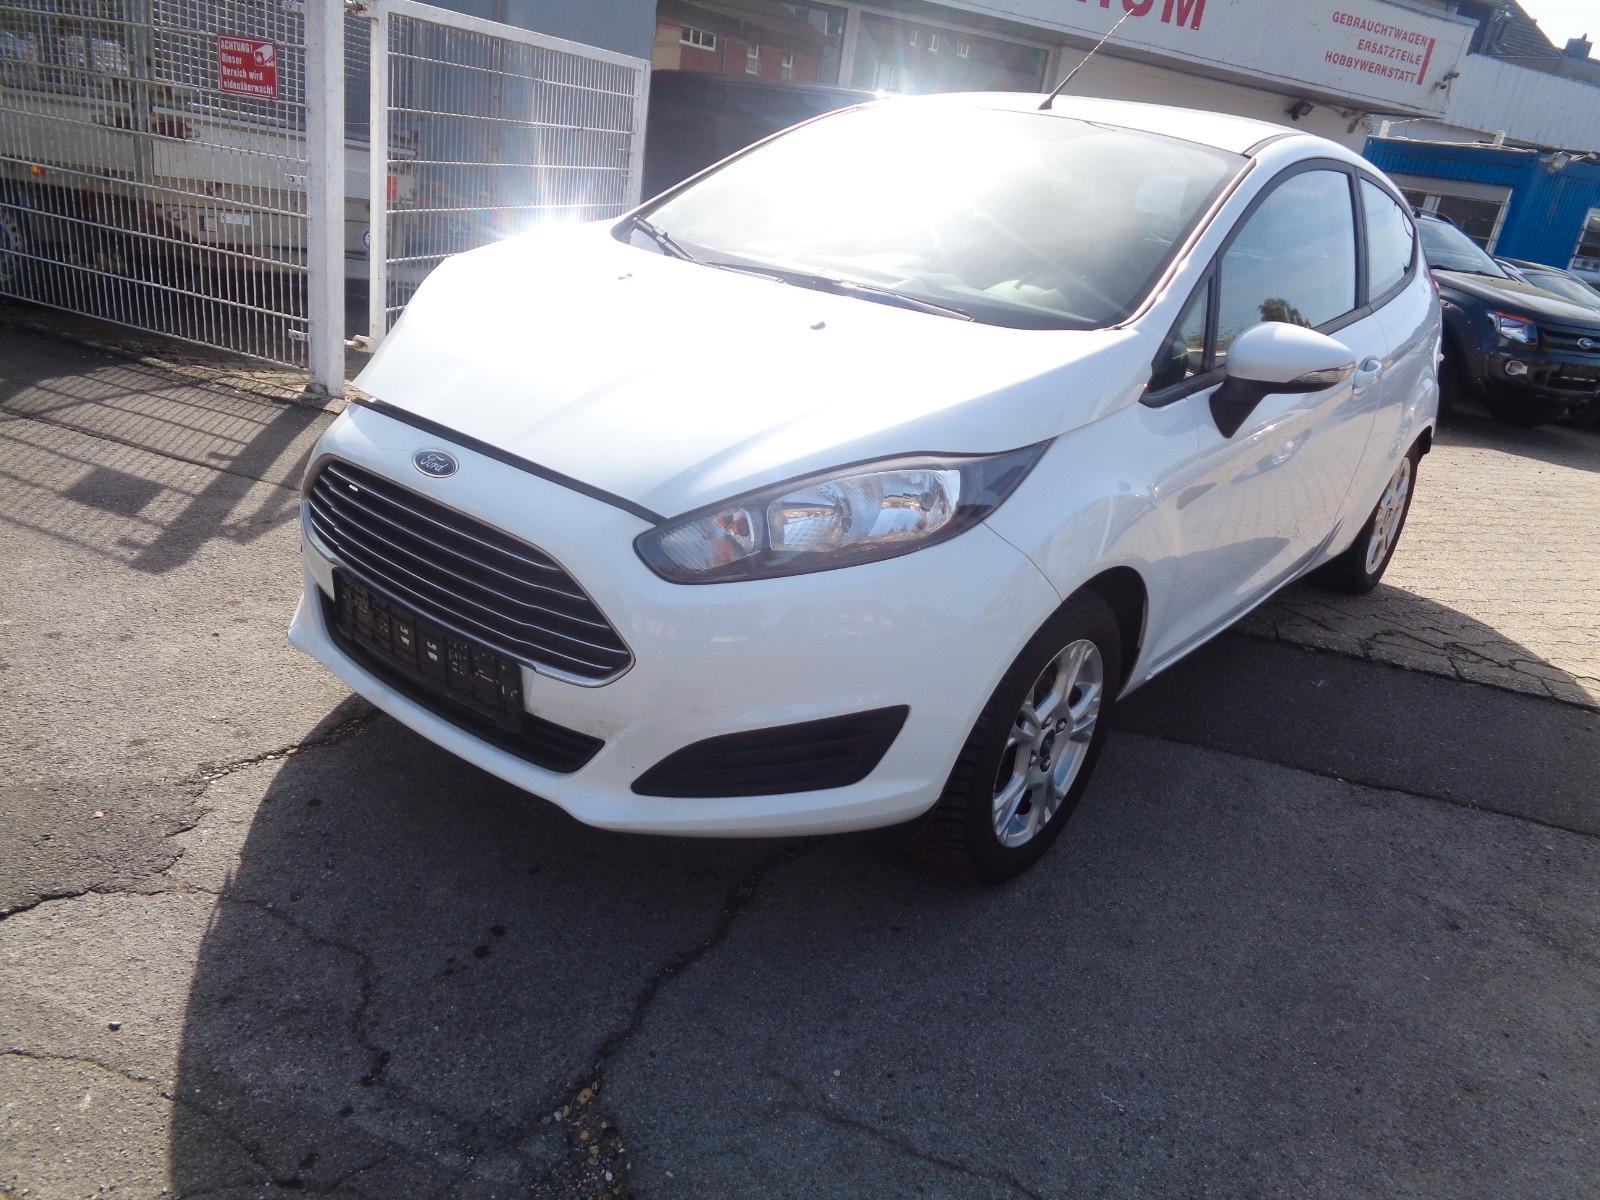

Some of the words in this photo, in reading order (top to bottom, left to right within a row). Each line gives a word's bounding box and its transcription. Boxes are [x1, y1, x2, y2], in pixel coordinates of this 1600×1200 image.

[1332, 11, 1428, 47] GEBRAUCHTWAGEN
[220, 40, 253, 53] ACHTUNG!
[1357, 39, 1422, 66] ERSATZTEILE
[221, 52, 242, 65] Dieser
[1324, 51, 1417, 83] HOBBYWERKSTATT
[222, 65, 247, 78] Bereich
[248, 70, 263, 81] wird
[420, 453, 449, 472] Ford
